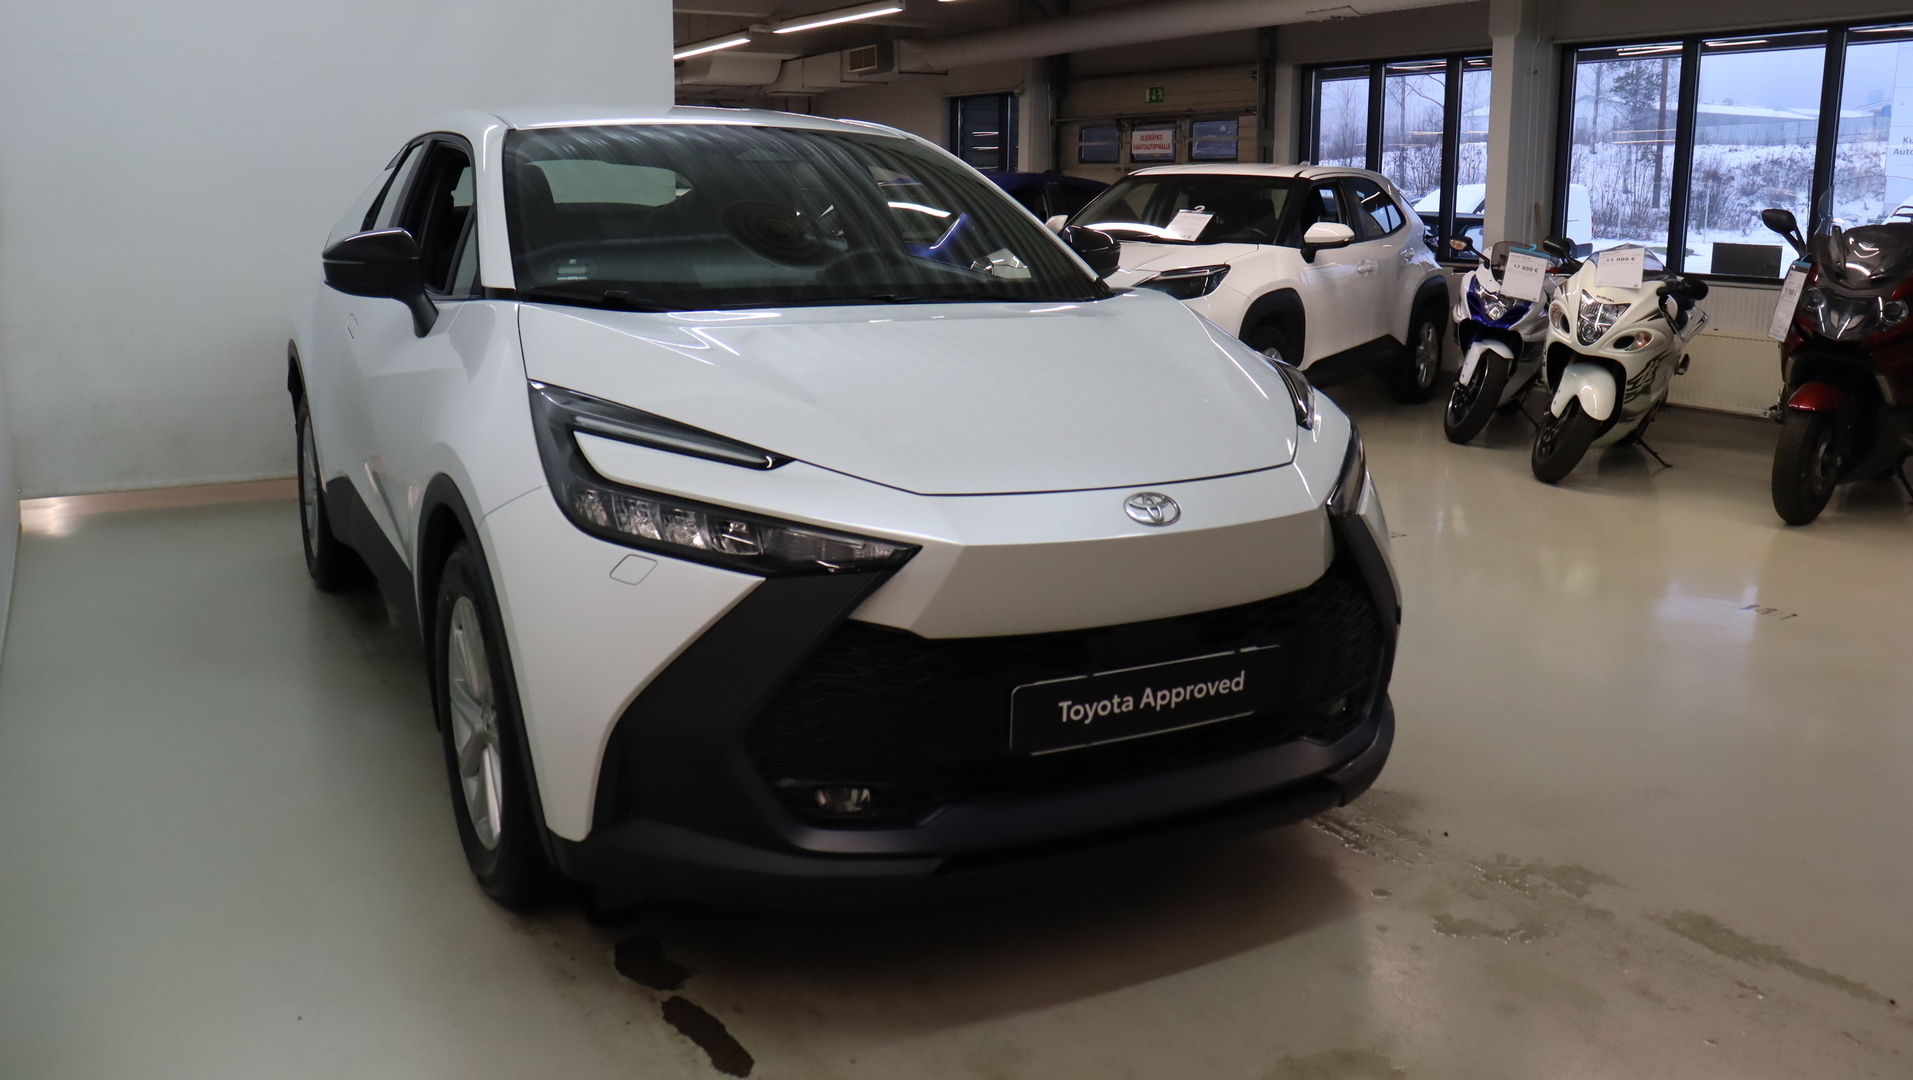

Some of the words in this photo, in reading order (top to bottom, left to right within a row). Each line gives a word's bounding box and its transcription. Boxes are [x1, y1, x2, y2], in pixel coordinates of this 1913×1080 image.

[1140, 133, 1164, 141] ULOSKÄYNTI
[1596, 294, 1615, 303] SUZUKI
[1058, 694, 1134, 724] Toyota
[1139, 669, 1245, 711] Approved
